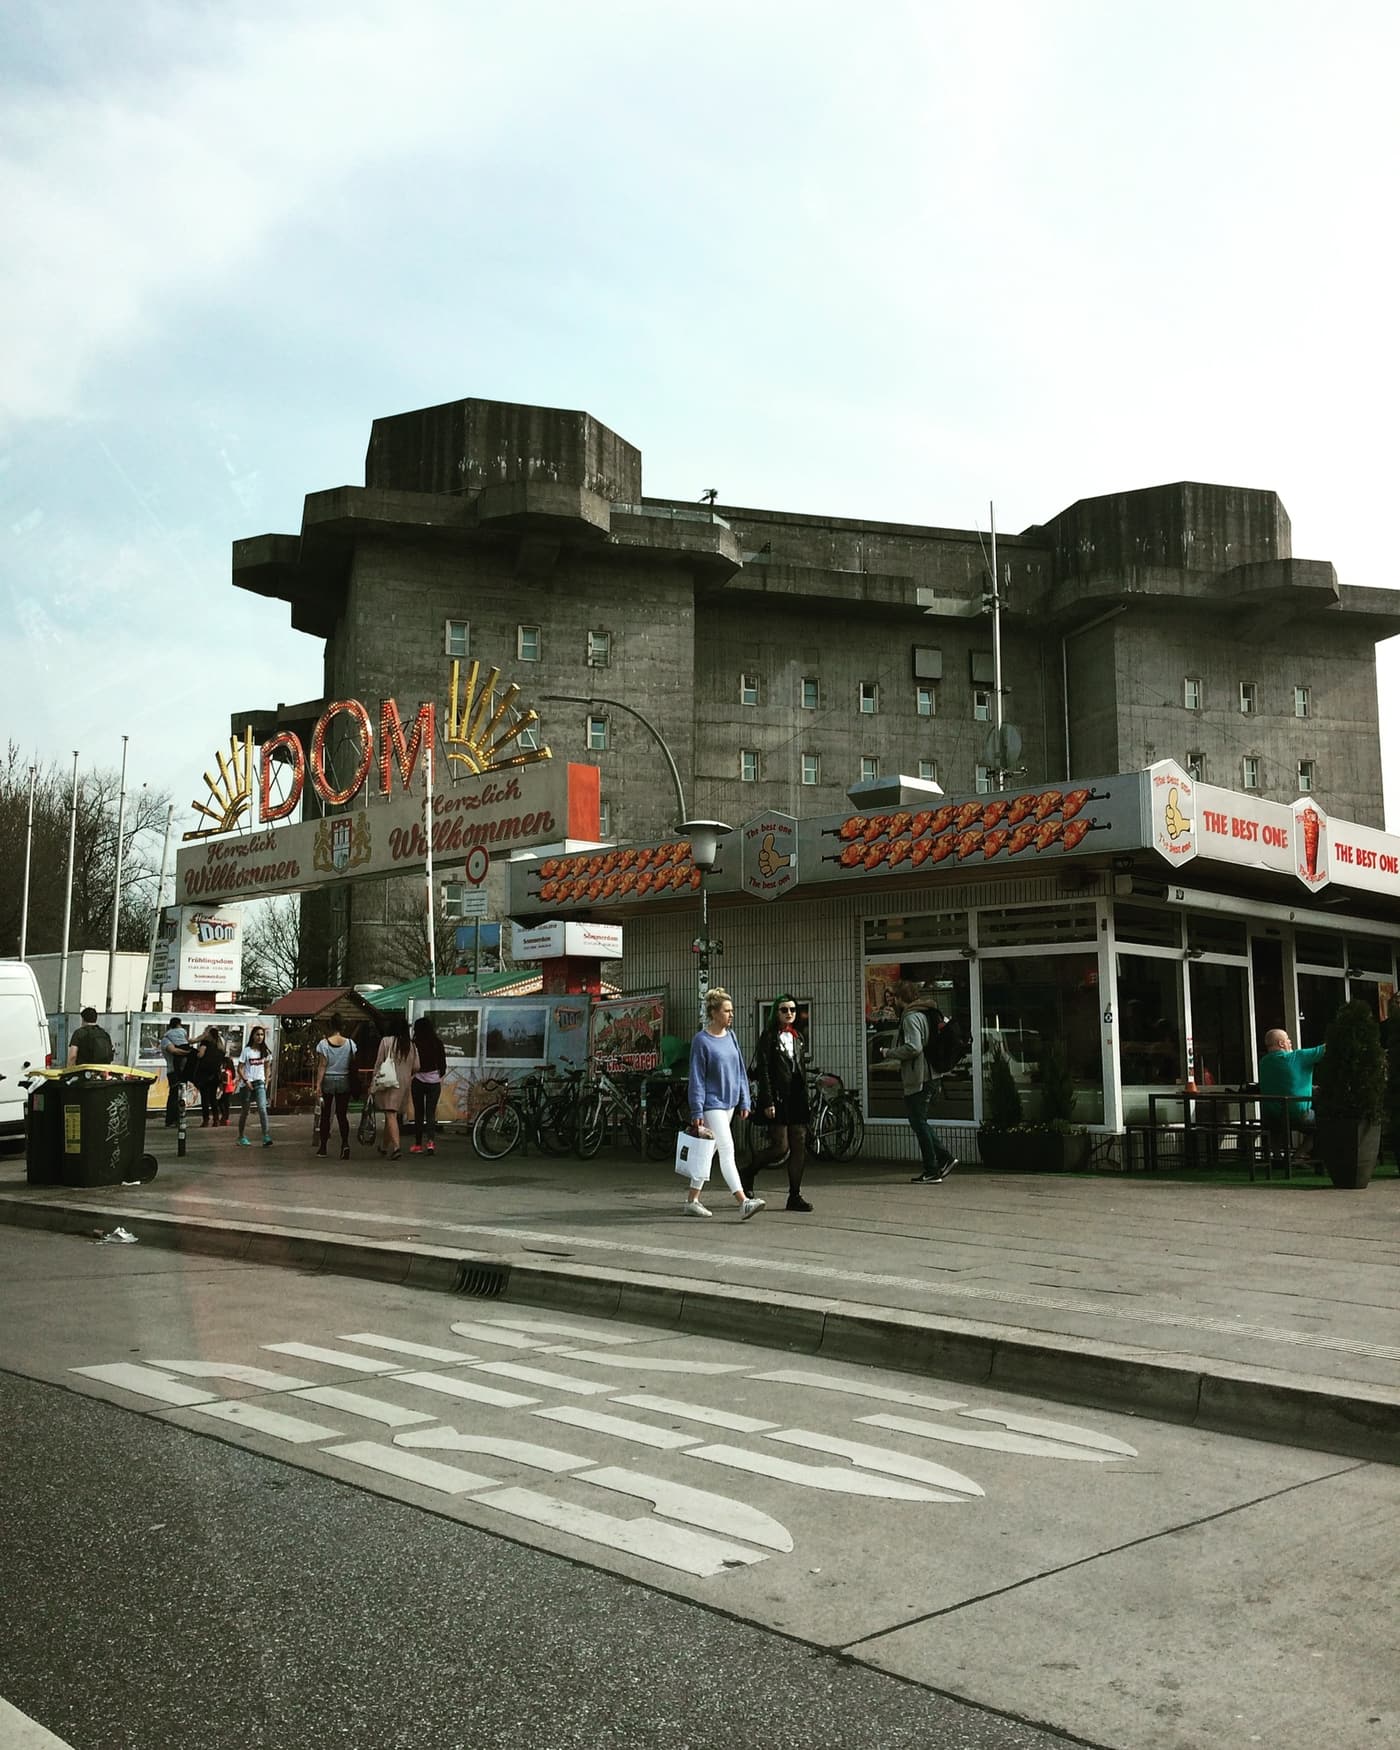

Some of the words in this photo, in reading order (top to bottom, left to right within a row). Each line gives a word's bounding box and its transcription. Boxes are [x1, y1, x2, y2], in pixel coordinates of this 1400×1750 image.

[259, 698, 435, 825] DOM
[746, 828, 759, 840] The
[761, 823, 776, 833] best
[778, 824, 793, 836] one
[1203, 810, 1229, 835] THE
[1231, 817, 1260, 843] BEST
[1262, 825, 1289, 849] ONE
[207, 831, 278, 865] Herzlich
[1334, 842, 1354, 864] THE
[1355, 849, 1378, 869] BEST
[1379, 856, 1400, 874] ONE
[184, 859, 301, 897] Willkommen
[188, 956, 234, 965] Frühlingsdom
